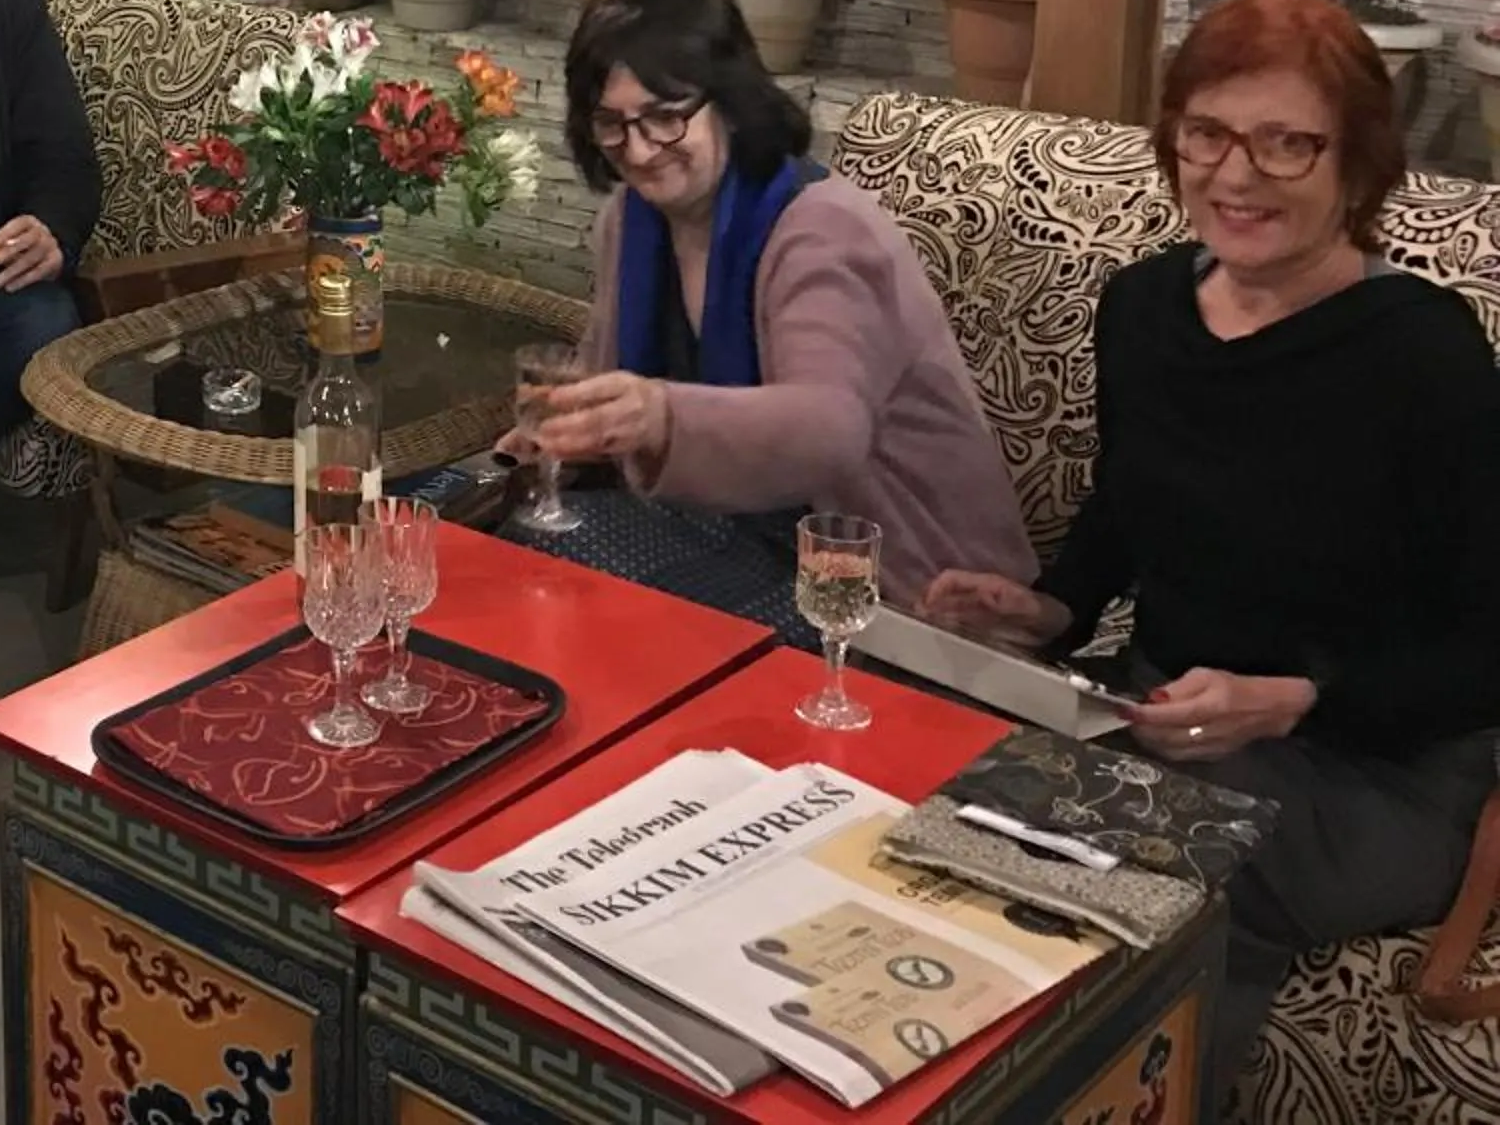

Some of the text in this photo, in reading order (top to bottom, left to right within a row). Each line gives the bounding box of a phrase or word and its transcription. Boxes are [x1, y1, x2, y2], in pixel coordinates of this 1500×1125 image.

[500, 868, 565, 894] The
[559, 779, 856, 926] SIKKIM EXPRESS
